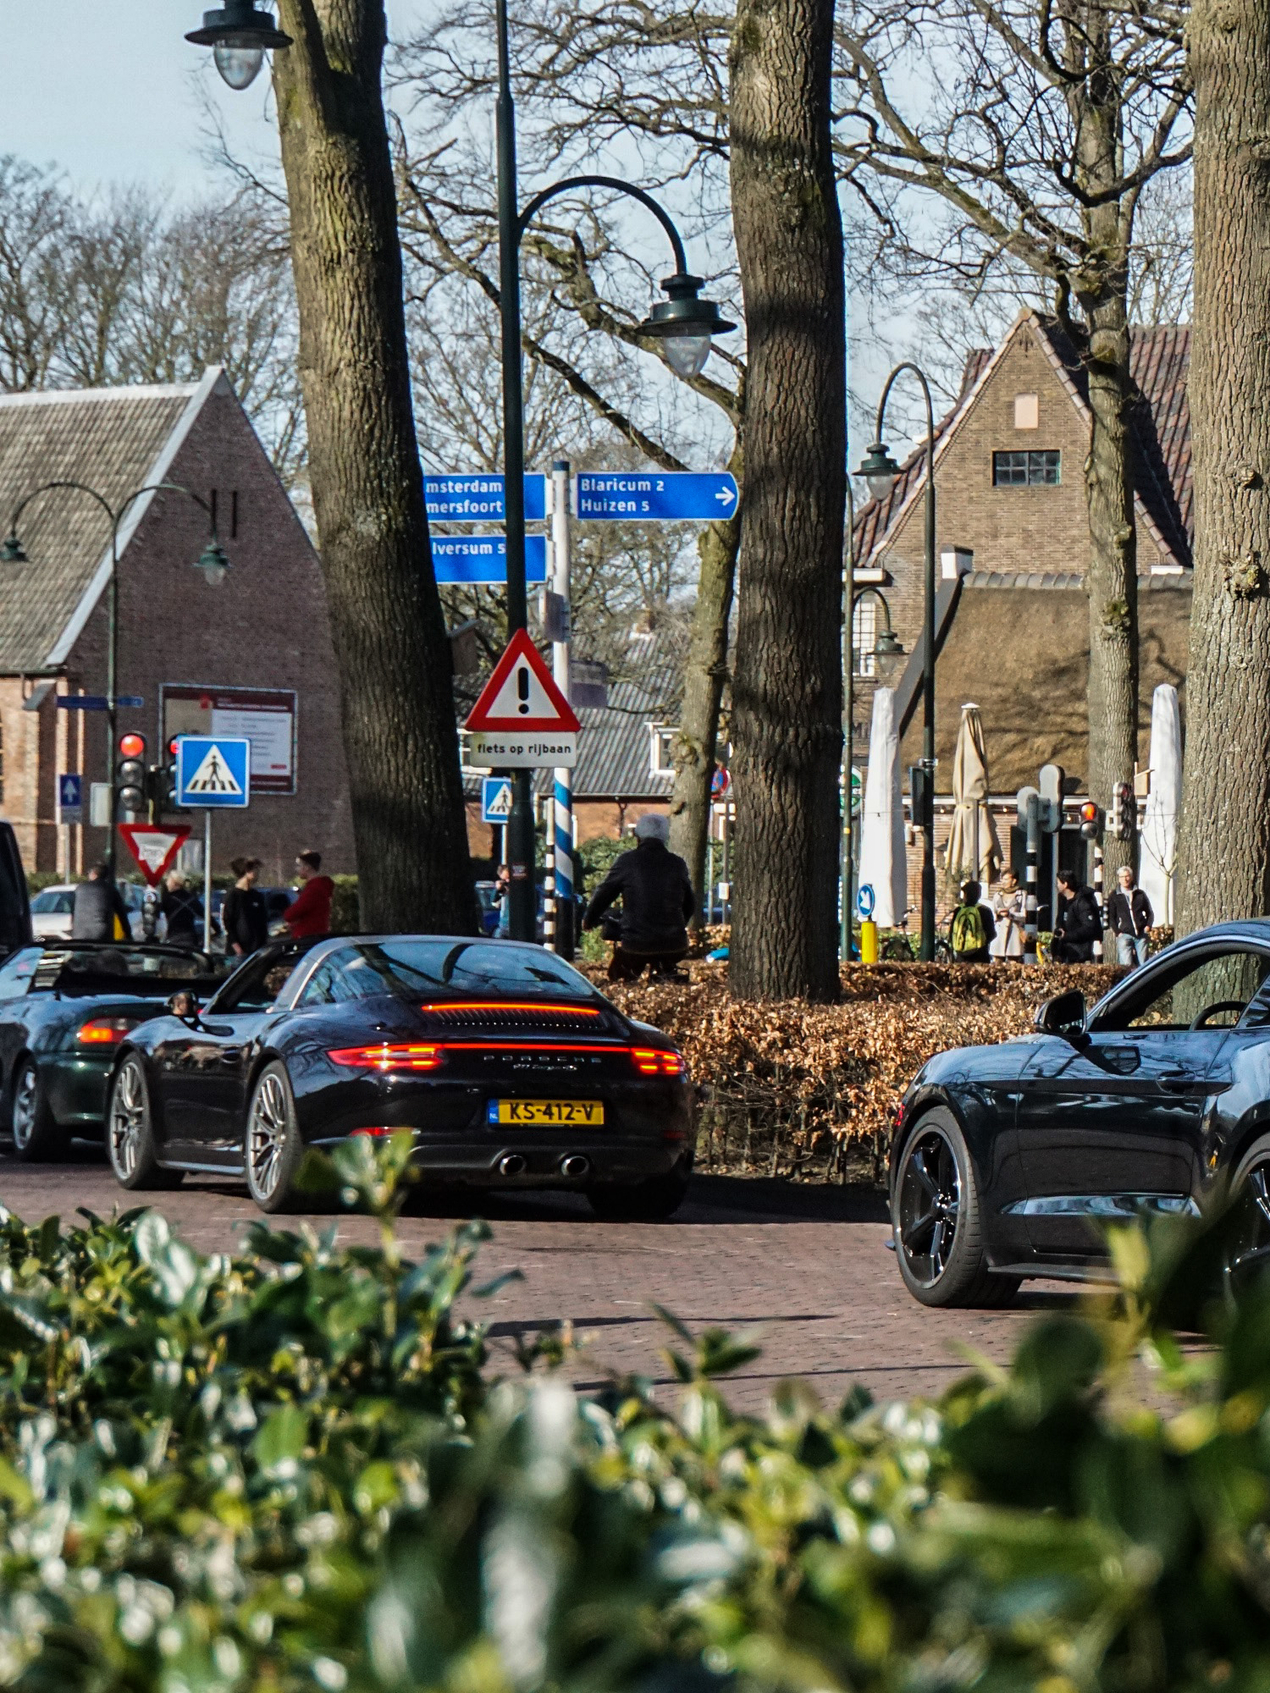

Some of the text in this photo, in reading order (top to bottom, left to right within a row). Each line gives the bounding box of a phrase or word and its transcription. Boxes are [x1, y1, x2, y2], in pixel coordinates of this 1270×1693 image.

[426, 479, 502, 493] msterdam
[581, 477, 664, 492] Blaricum 2
[426, 499, 503, 514] mersfoort
[581, 498, 650, 512] Huizen 5
[432, 541, 493, 555] lversum
[477, 743, 572, 756] fiets op rijbaan
[509, 1102, 594, 1122] KS-412-V
